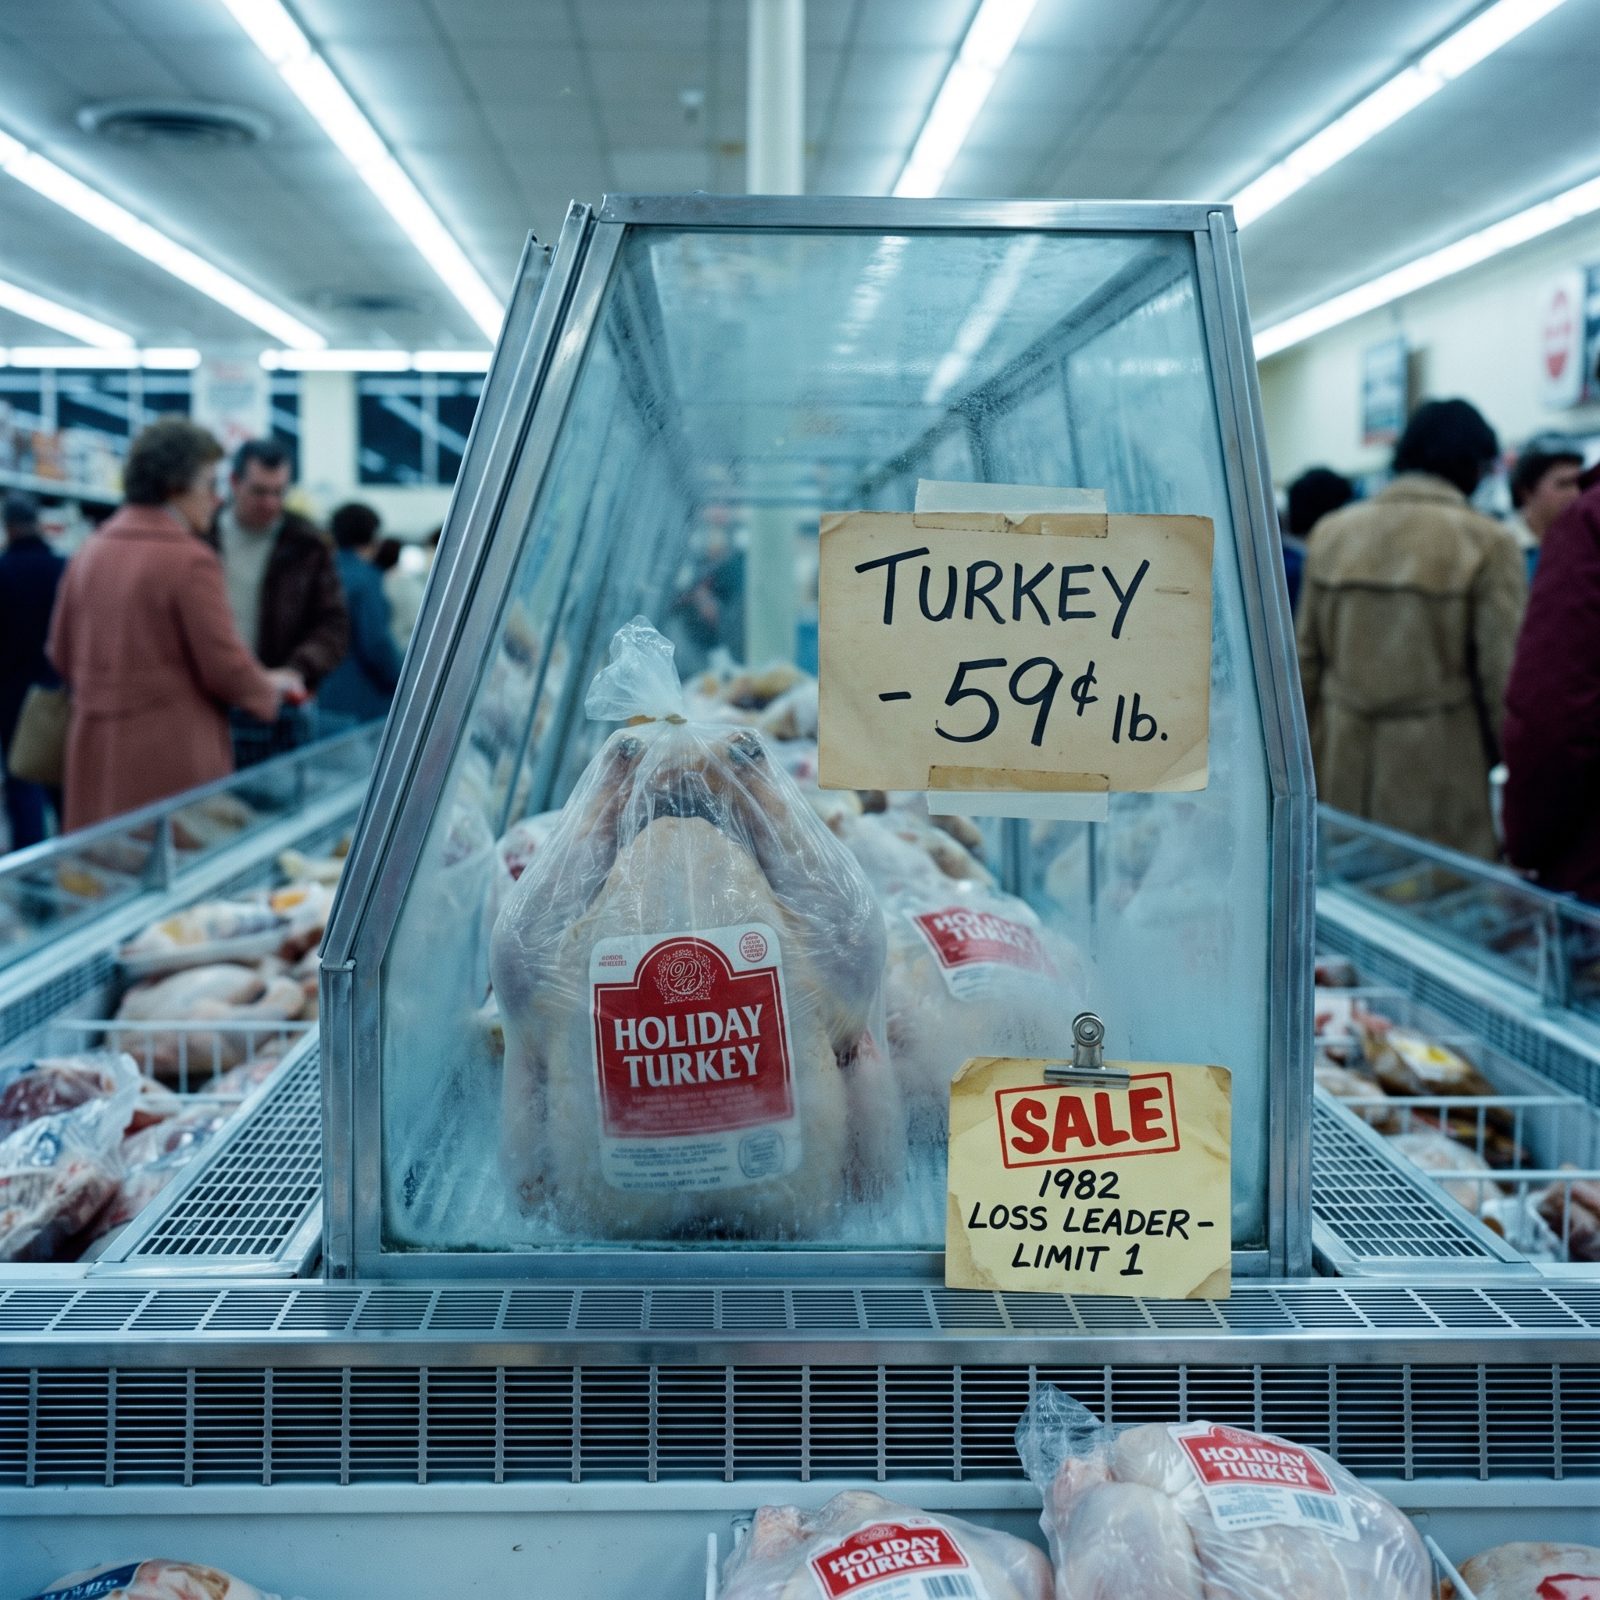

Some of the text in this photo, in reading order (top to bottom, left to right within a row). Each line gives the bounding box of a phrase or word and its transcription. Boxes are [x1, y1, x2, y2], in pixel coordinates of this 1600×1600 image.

[855, 547, 1150, 639] TURKEY
[935, 656, 1098, 747] 59¢
[1112, 693, 1168, 743] lb.
[613, 1003, 763, 1051] HOLIDAY
[623, 1043, 761, 1088] TURKEY
[1010, 1087, 1168, 1154] SALE
[1038, 1168, 1120, 1200] 1982
[968, 1201, 1048, 1231] LOSS
[1011, 1242, 1144, 1276] LIMIT 1
[1198, 1446, 1306, 1468] HOLIDAY
[1213, 1462, 1309, 1485] TURKEY
[828, 1536, 940, 1575] HOLIDAY
[840, 1548, 942, 1586] TURKEY
